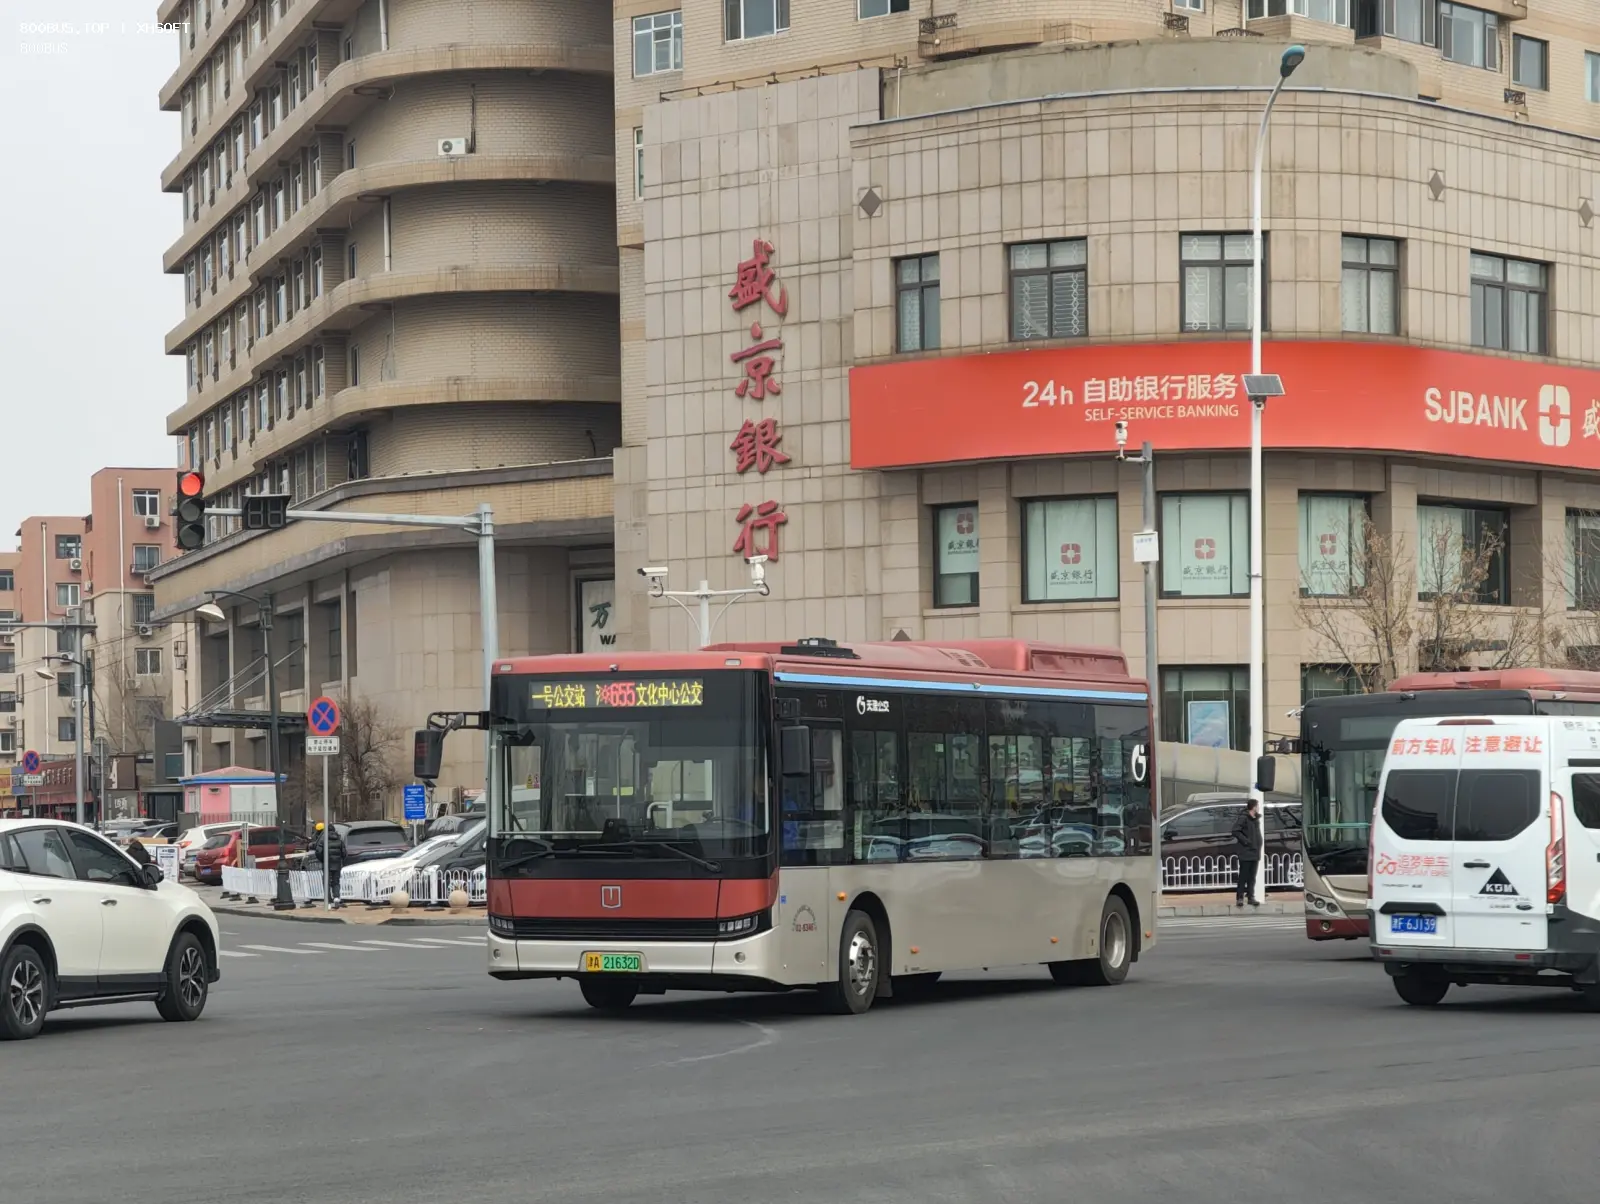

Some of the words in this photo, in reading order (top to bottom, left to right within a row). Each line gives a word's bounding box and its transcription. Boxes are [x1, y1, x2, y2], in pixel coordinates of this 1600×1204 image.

[727, 239, 791, 562] 盛京銀行
[1022, 379, 1074, 408] 24h
[1083, 373, 1238, 404] 自助银行服务
[1084, 405, 1175, 422] SELF-SERVICE
[1177, 404, 1239, 418] BANKING
[1424, 387, 1528, 431] SJBANK
[531, 684, 586, 708] 一号公交站
[1391, 737, 1457, 756] 前方车队
[1464, 735, 1543, 754] 注意避让
